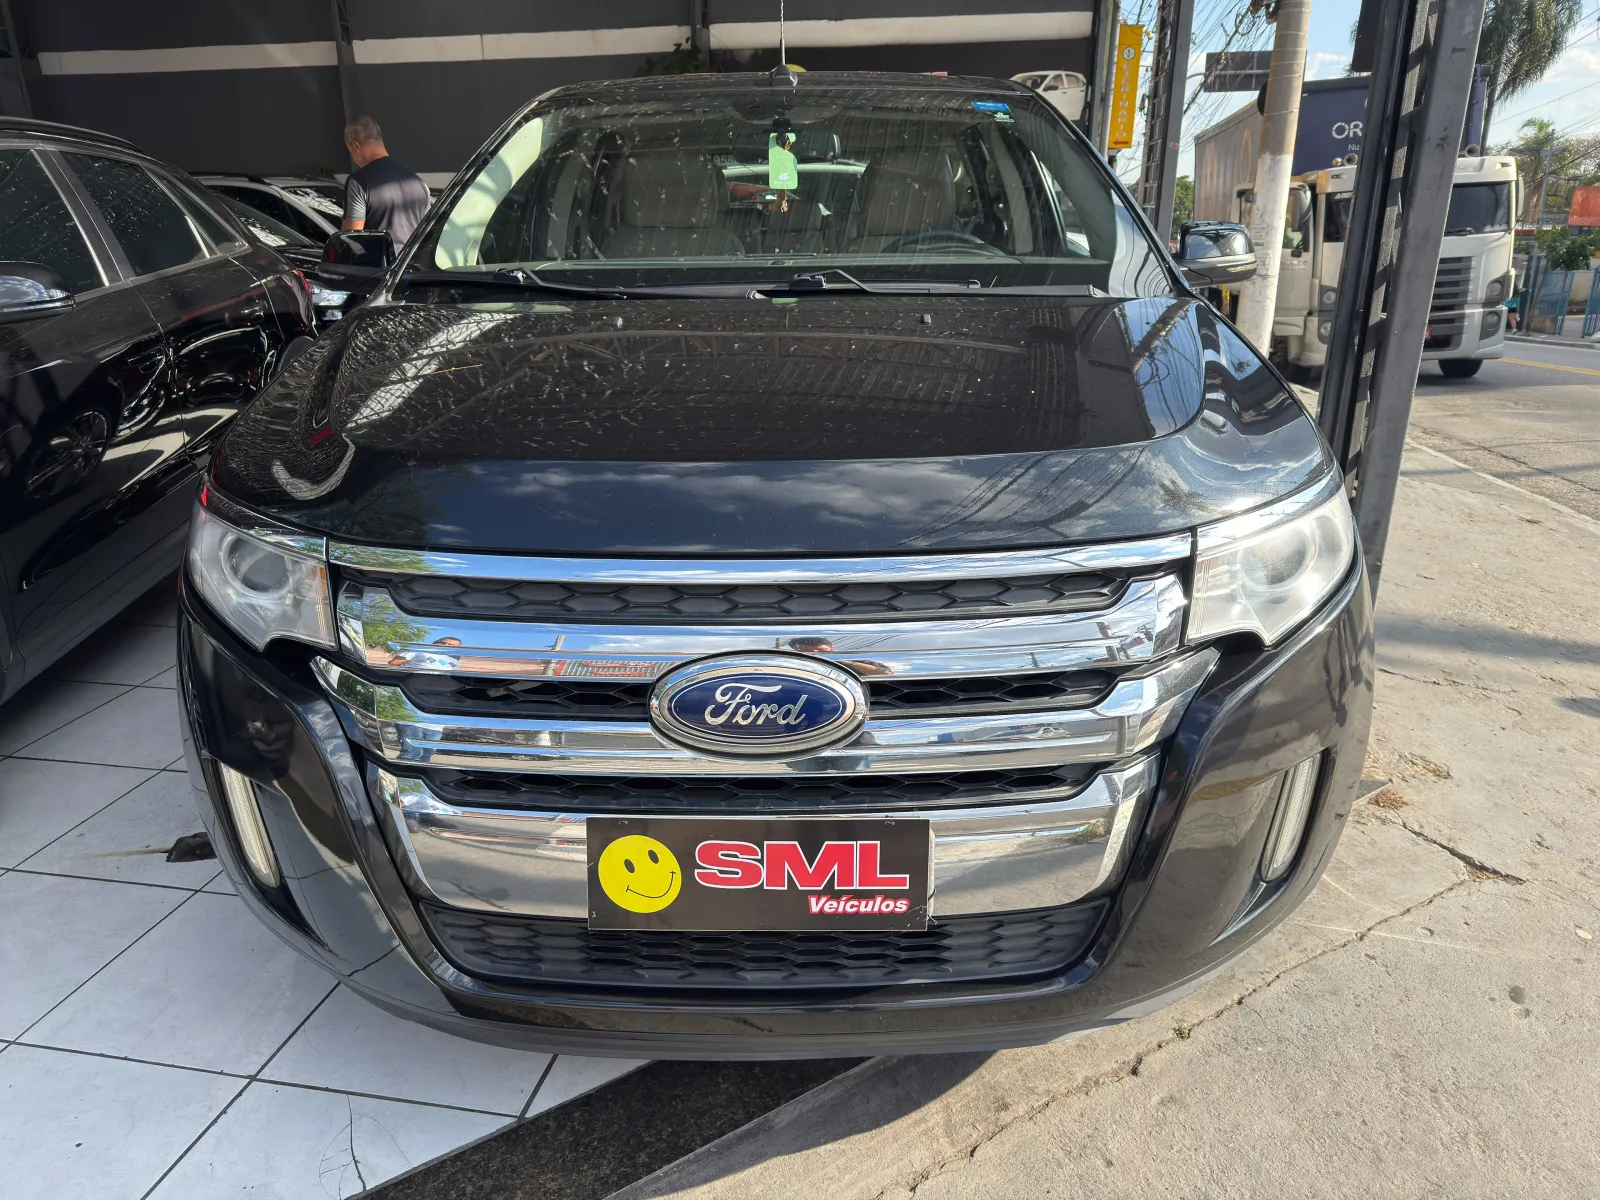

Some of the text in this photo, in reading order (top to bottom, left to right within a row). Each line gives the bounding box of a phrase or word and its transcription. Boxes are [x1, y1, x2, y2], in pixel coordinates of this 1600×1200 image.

[704, 682, 808, 726] Ford
[694, 840, 910, 890] SML
[808, 894, 910, 915] Veículos
